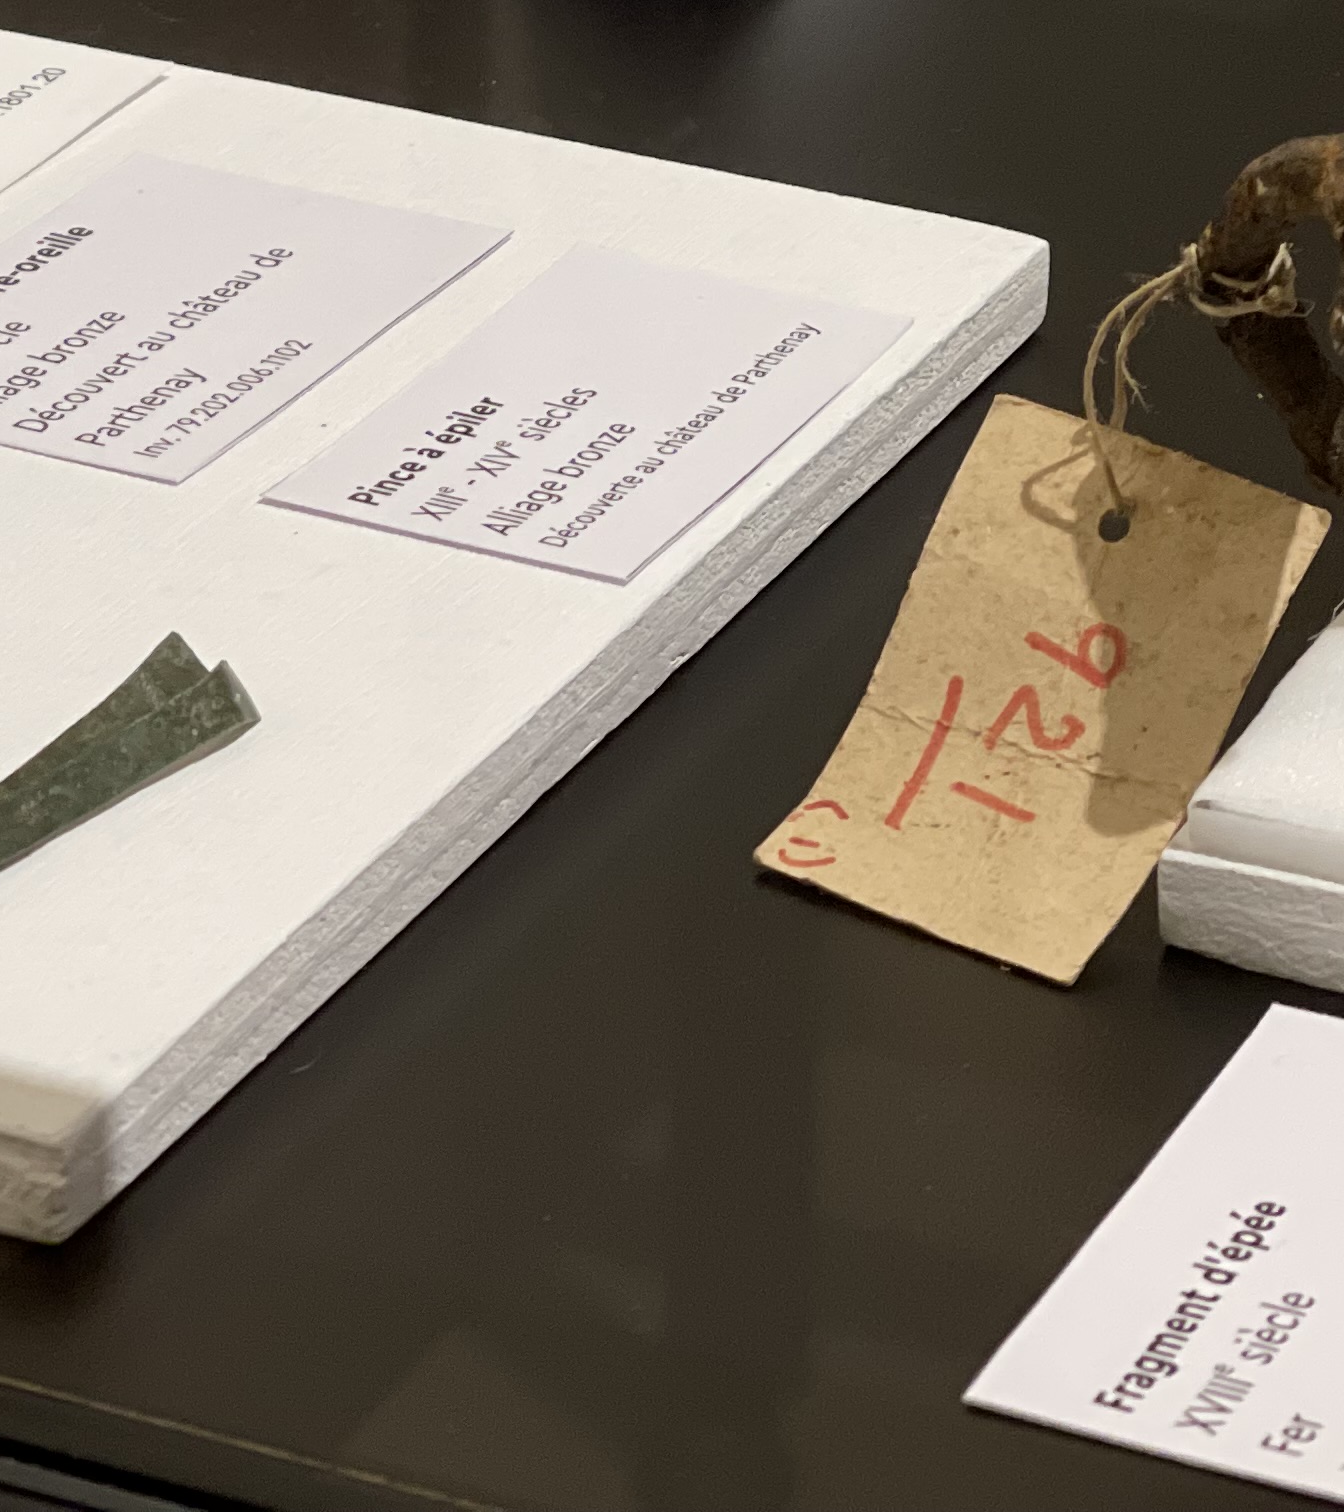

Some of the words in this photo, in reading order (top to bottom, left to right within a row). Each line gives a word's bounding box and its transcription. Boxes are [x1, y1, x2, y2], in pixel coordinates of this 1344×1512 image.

[11, 351, 149, 433] Découvert
[137, 330, 176, 351] au
[167, 269, 262, 329] château
[249, 247, 293, 268] de
[25, 311, 125, 364] bronze
[73, 367, 207, 447] Parthenay
[132, 436, 181, 458] Inv.
[516, 387, 597, 441] siècles
[537, 474, 644, 548] Découverte
[634, 456, 665, 474] au
[653, 404, 725, 455] château
[710, 386, 747, 403] de
[730, 322, 821, 385] Parthenay
[346, 461, 427, 506] Pince
[402, 447, 445, 459] à
[424, 396, 504, 444] épiler
[480, 480, 567, 536] Alliage
[542, 423, 636, 478] bronze
[1092, 1288, 1221, 1413] Fragment
[1192, 1201, 1286, 1285] d'épée
[1233, 1291, 1315, 1365] siècle
[1259, 1412, 1323, 1457] Fer
